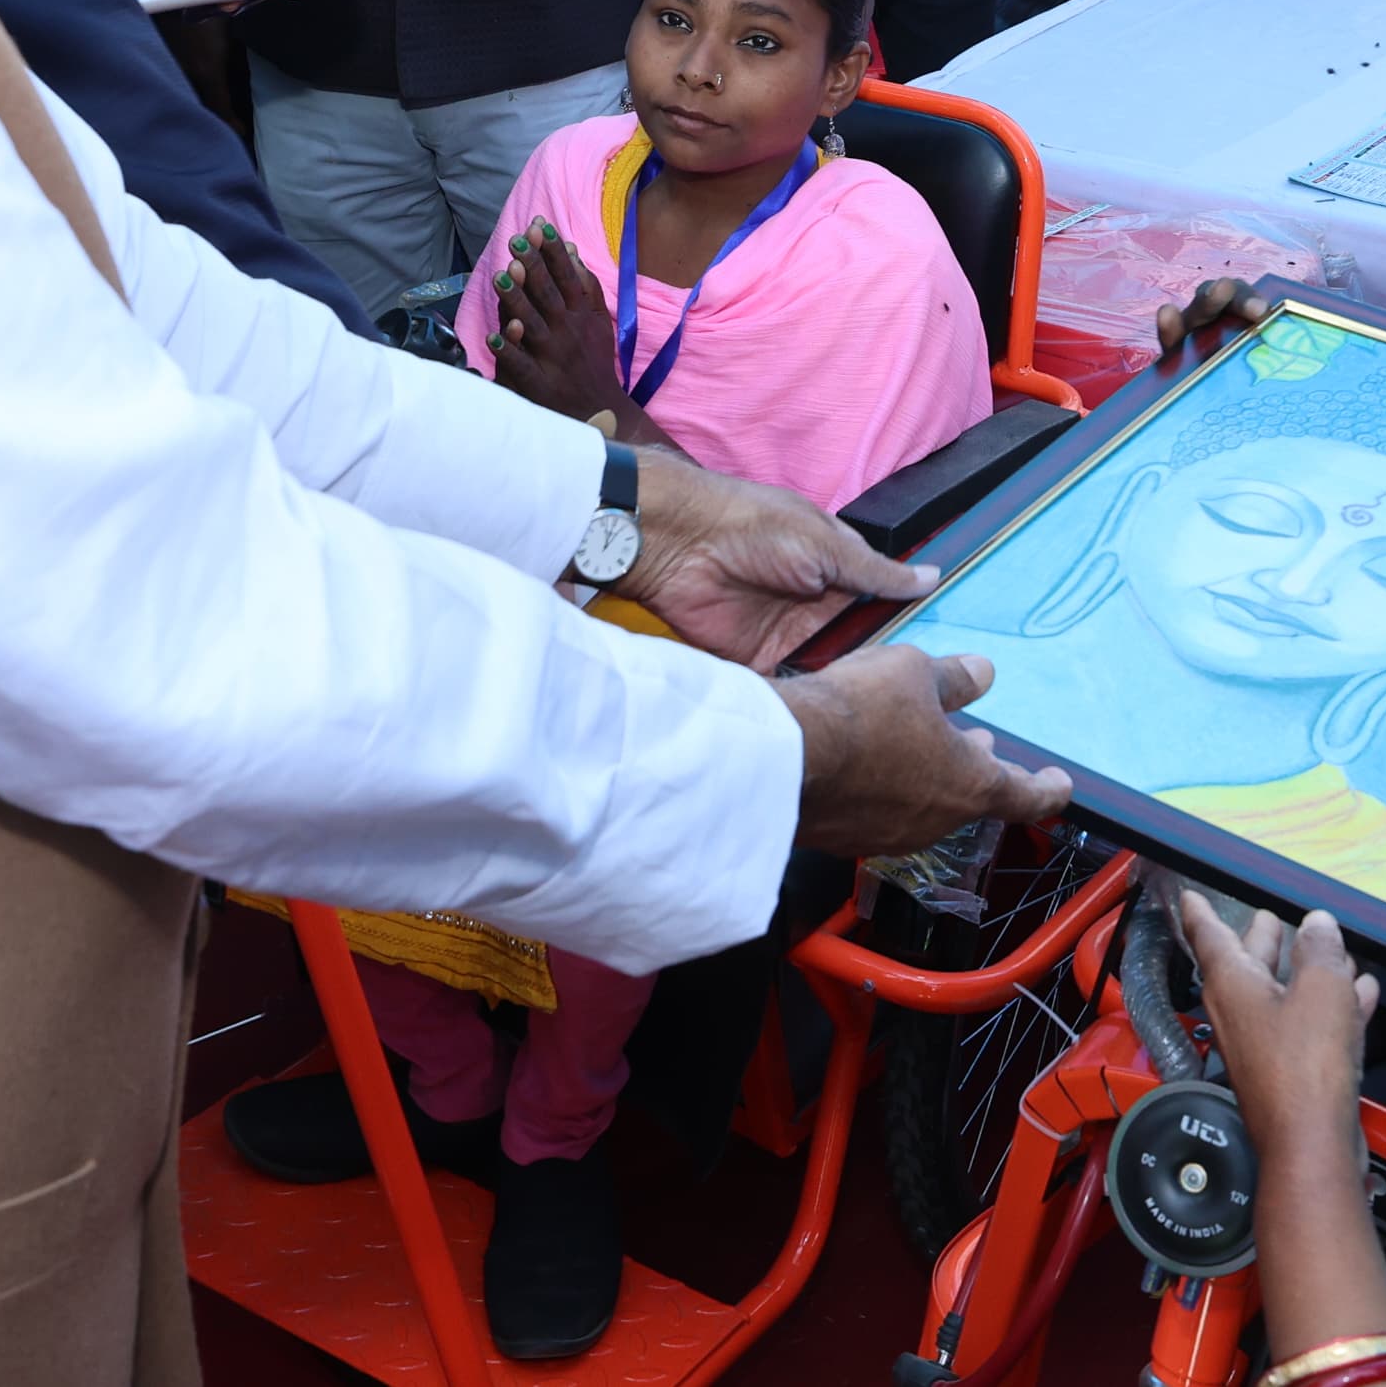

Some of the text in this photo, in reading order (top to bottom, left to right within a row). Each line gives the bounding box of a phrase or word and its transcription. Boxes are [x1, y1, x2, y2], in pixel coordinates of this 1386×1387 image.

[1140, 1152, 1157, 1168] DC
[1230, 1190, 1250, 1206] 12V
[1144, 1197, 1225, 1239] MADE IN INDIA
